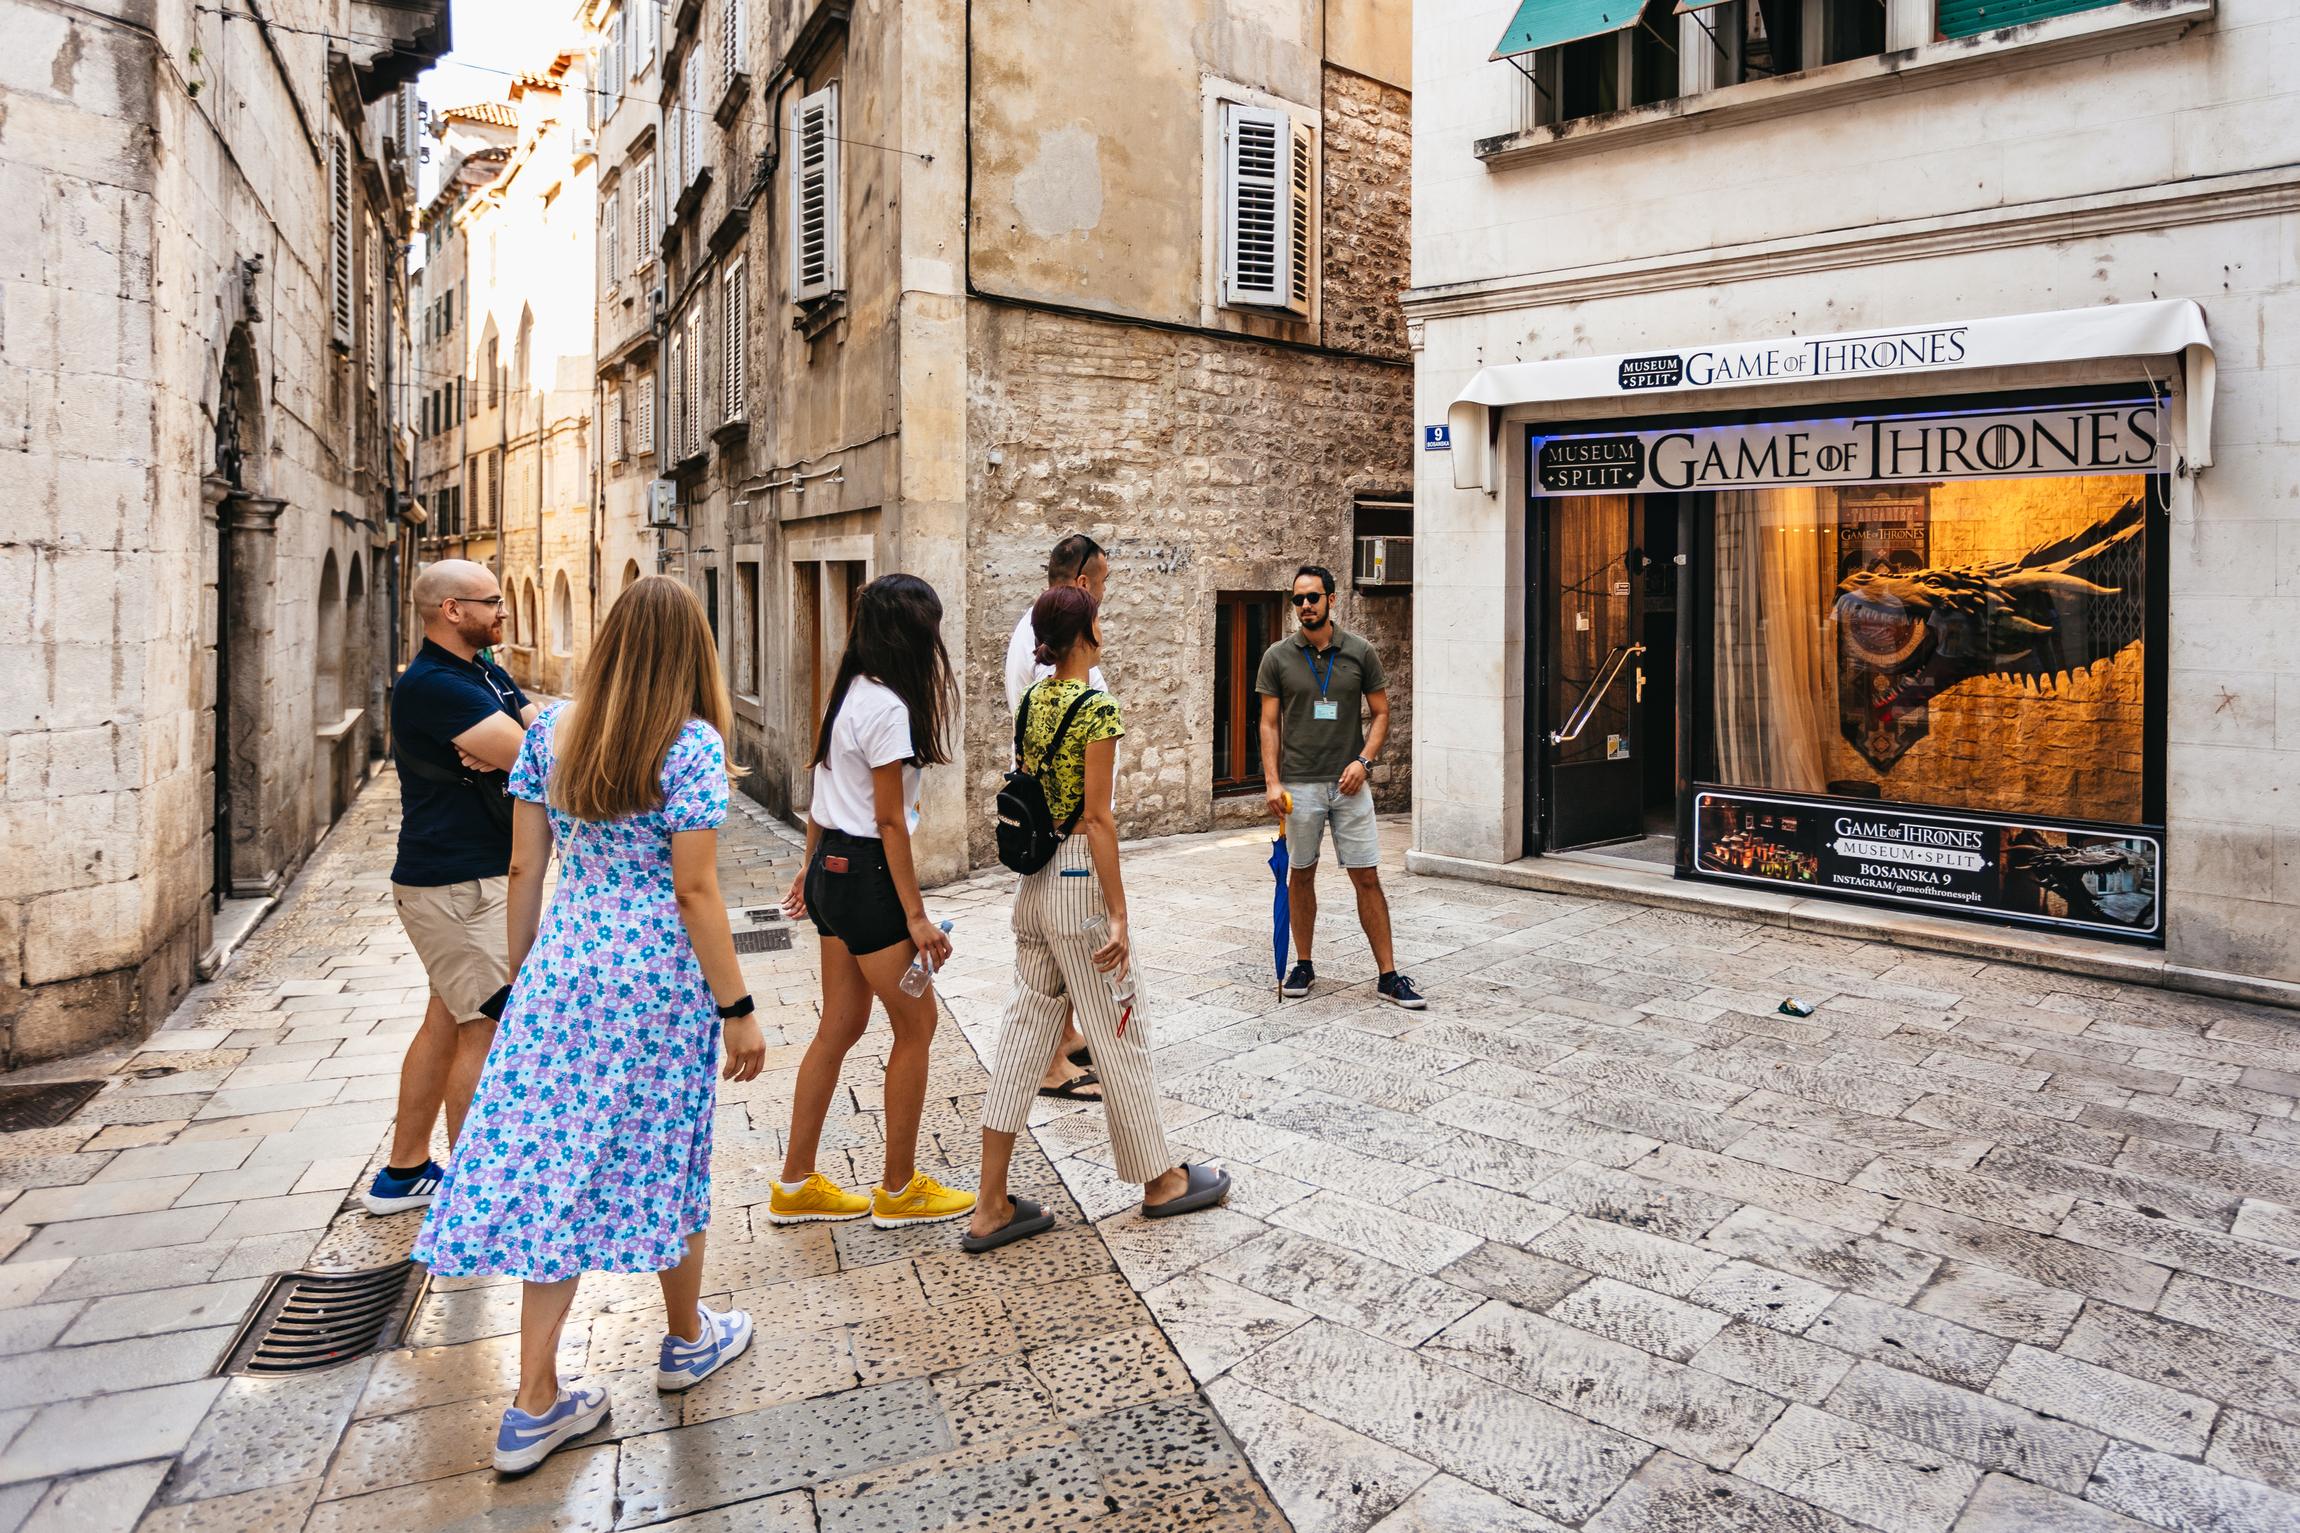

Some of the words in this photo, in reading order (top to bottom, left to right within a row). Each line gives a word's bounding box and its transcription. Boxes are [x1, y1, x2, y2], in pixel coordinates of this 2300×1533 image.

[1623, 358, 1678, 373] MUSEUM
[1686, 350, 1780, 386] GAME
[1784, 354, 1807, 372] OF
[1805, 327, 1968, 376] THRONES
[1629, 374, 1669, 387] SPLIT
[1434, 427, 1443, 441] 9
[1549, 443, 1635, 463] MUSEUM
[1648, 433, 1811, 490] GAME
[1816, 442, 1858, 472] OF
[1852, 401, 2165, 479] THRONES
[1558, 468, 1622, 487] SPLIT
[1841, 529, 1872, 540] GAME
[1878, 528, 1925, 540] THRONES
[1834, 817, 1888, 838] GAME
[1888, 828, 1901, 839] OF
[1899, 823, 1983, 849] THRONES
[1843, 842, 1915, 861] MUSEUM
[1925, 852, 1975, 867] SPLIT
[1860, 863, 1940, 885] BOSANSKA
[1942, 873, 1952, 886] 9
